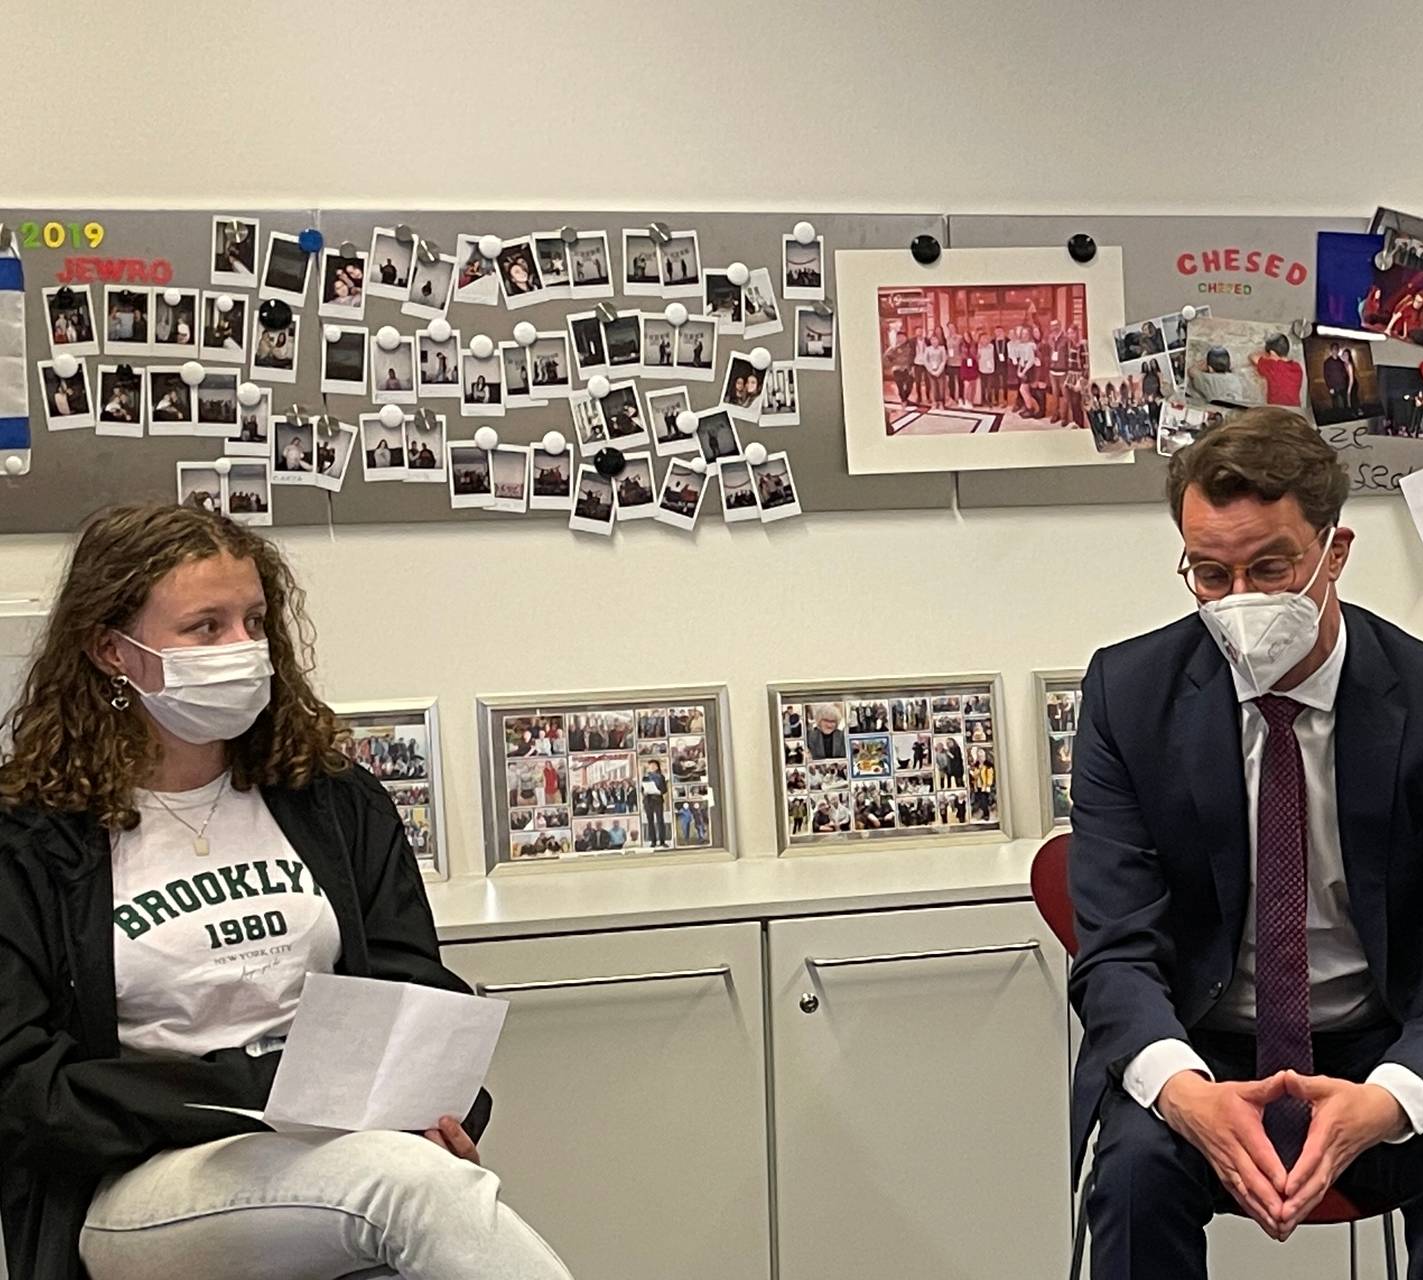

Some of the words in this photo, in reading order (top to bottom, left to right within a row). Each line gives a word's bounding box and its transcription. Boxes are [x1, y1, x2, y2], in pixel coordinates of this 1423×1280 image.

[20, 221, 105, 249] 2019
[56, 256, 174, 285] JEWRO
[1176, 248, 1308, 286] CHESED
[113, 858, 324, 941] BROOKLY
[204, 910, 288, 950] 1980
[214, 955, 237, 965] NEW
[239, 949, 269, 960] YORK
[269, 944, 293, 955] CITY
